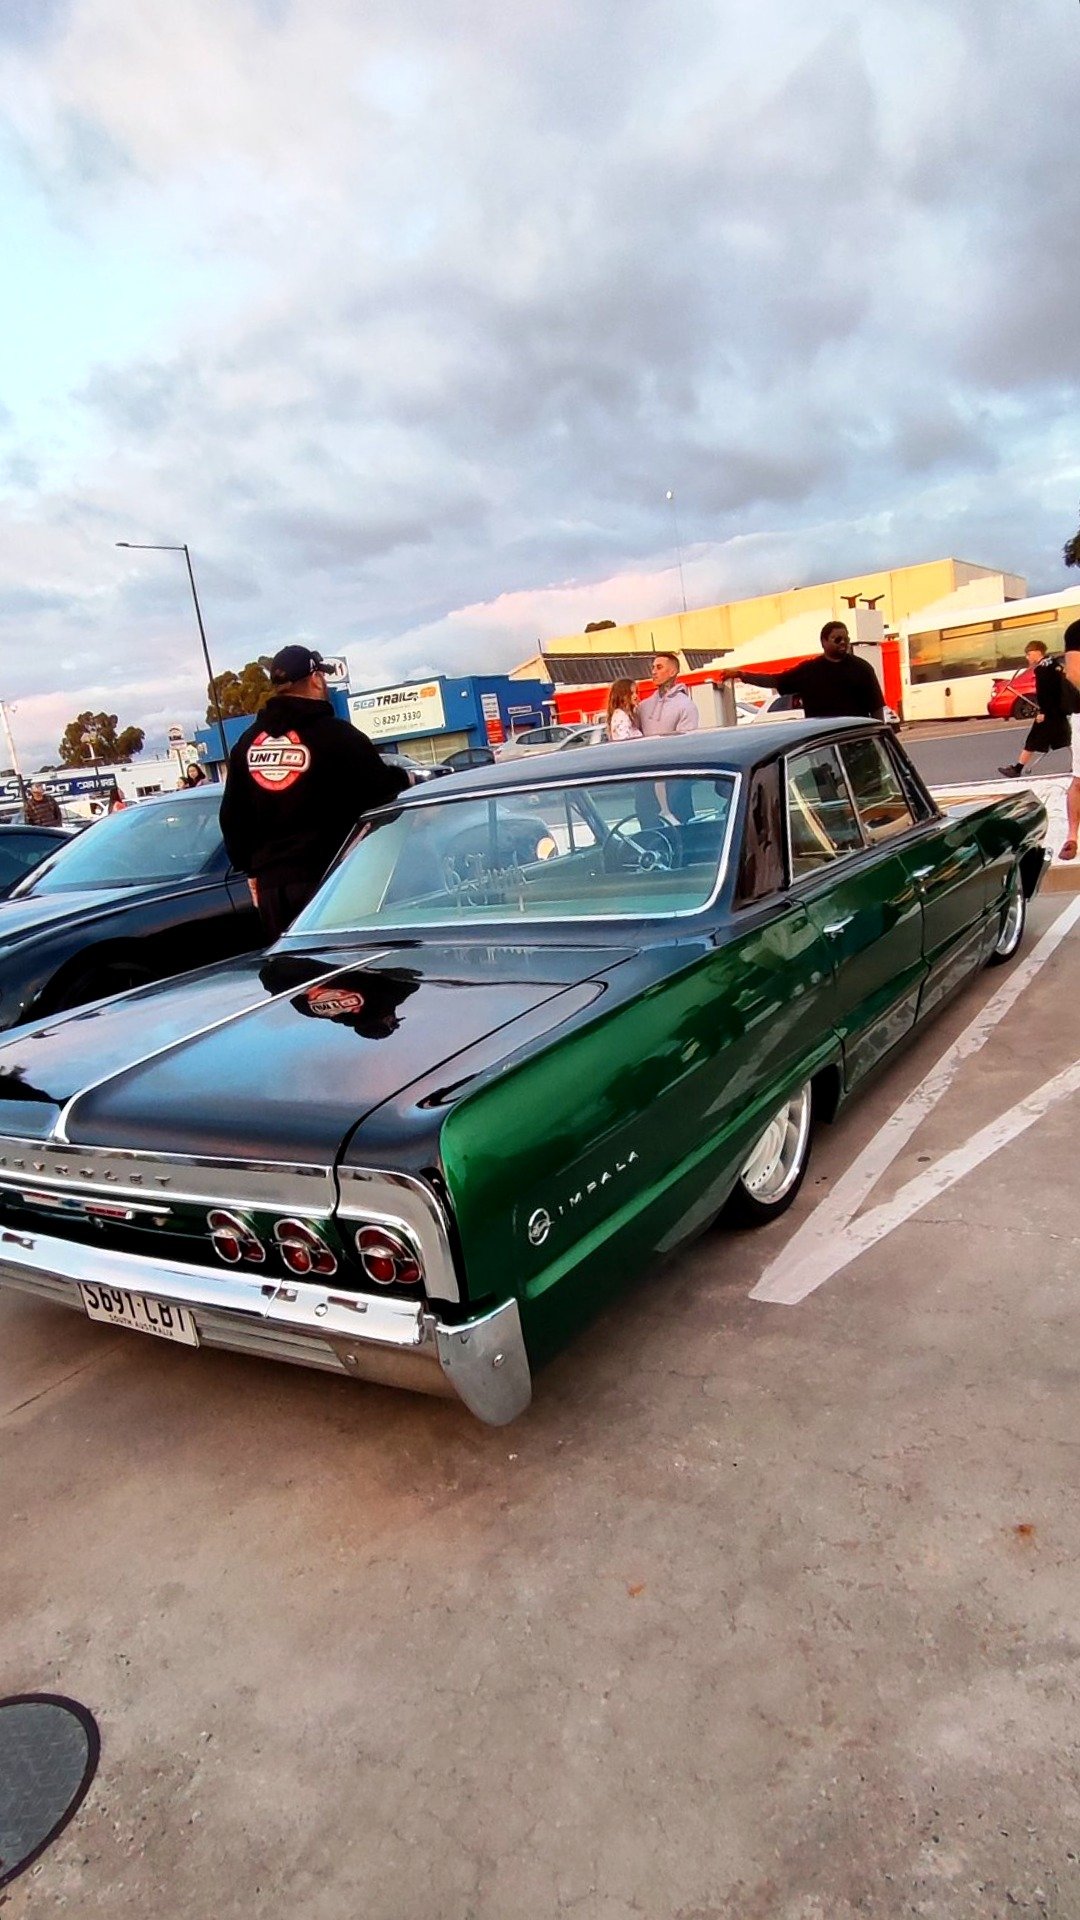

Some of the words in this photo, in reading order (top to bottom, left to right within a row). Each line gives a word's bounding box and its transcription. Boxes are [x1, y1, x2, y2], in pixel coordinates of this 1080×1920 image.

[382, 714, 400, 725] 8297
[402, 711, 421, 722] 3330
[250, 753, 279, 763] UNIT
[77, 780, 95, 790] CAR
[558, 1151, 639, 1215] IMPALA
[109, 1314, 132, 1325] SOUTH
[135, 1321, 174, 1337] AUSTRALIA
